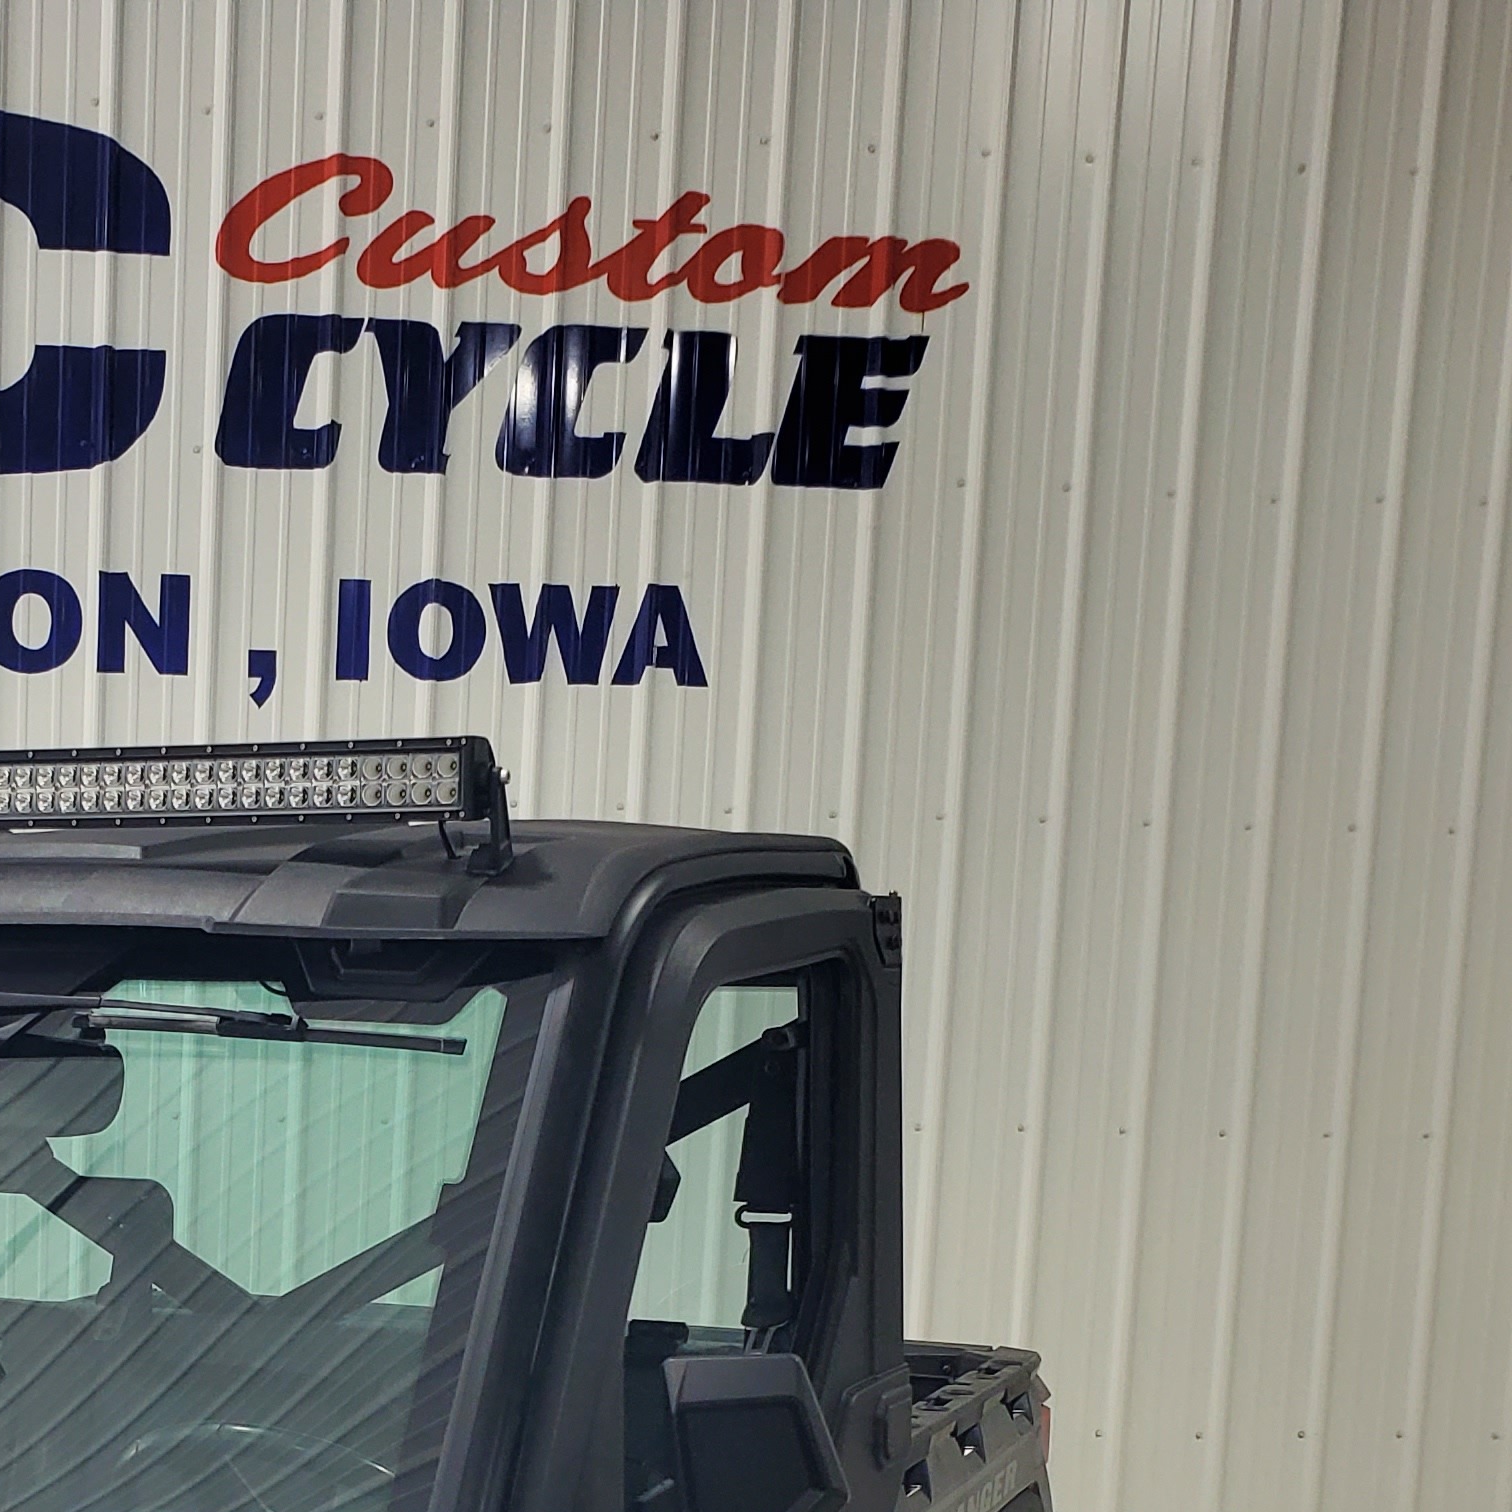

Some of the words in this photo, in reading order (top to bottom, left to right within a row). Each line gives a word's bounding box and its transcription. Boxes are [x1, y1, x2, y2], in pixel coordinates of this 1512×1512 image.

[215, 152, 971, 314] Custom
[213, 313, 931, 490] CYCLE
[334, 578, 710, 688] IOWA
